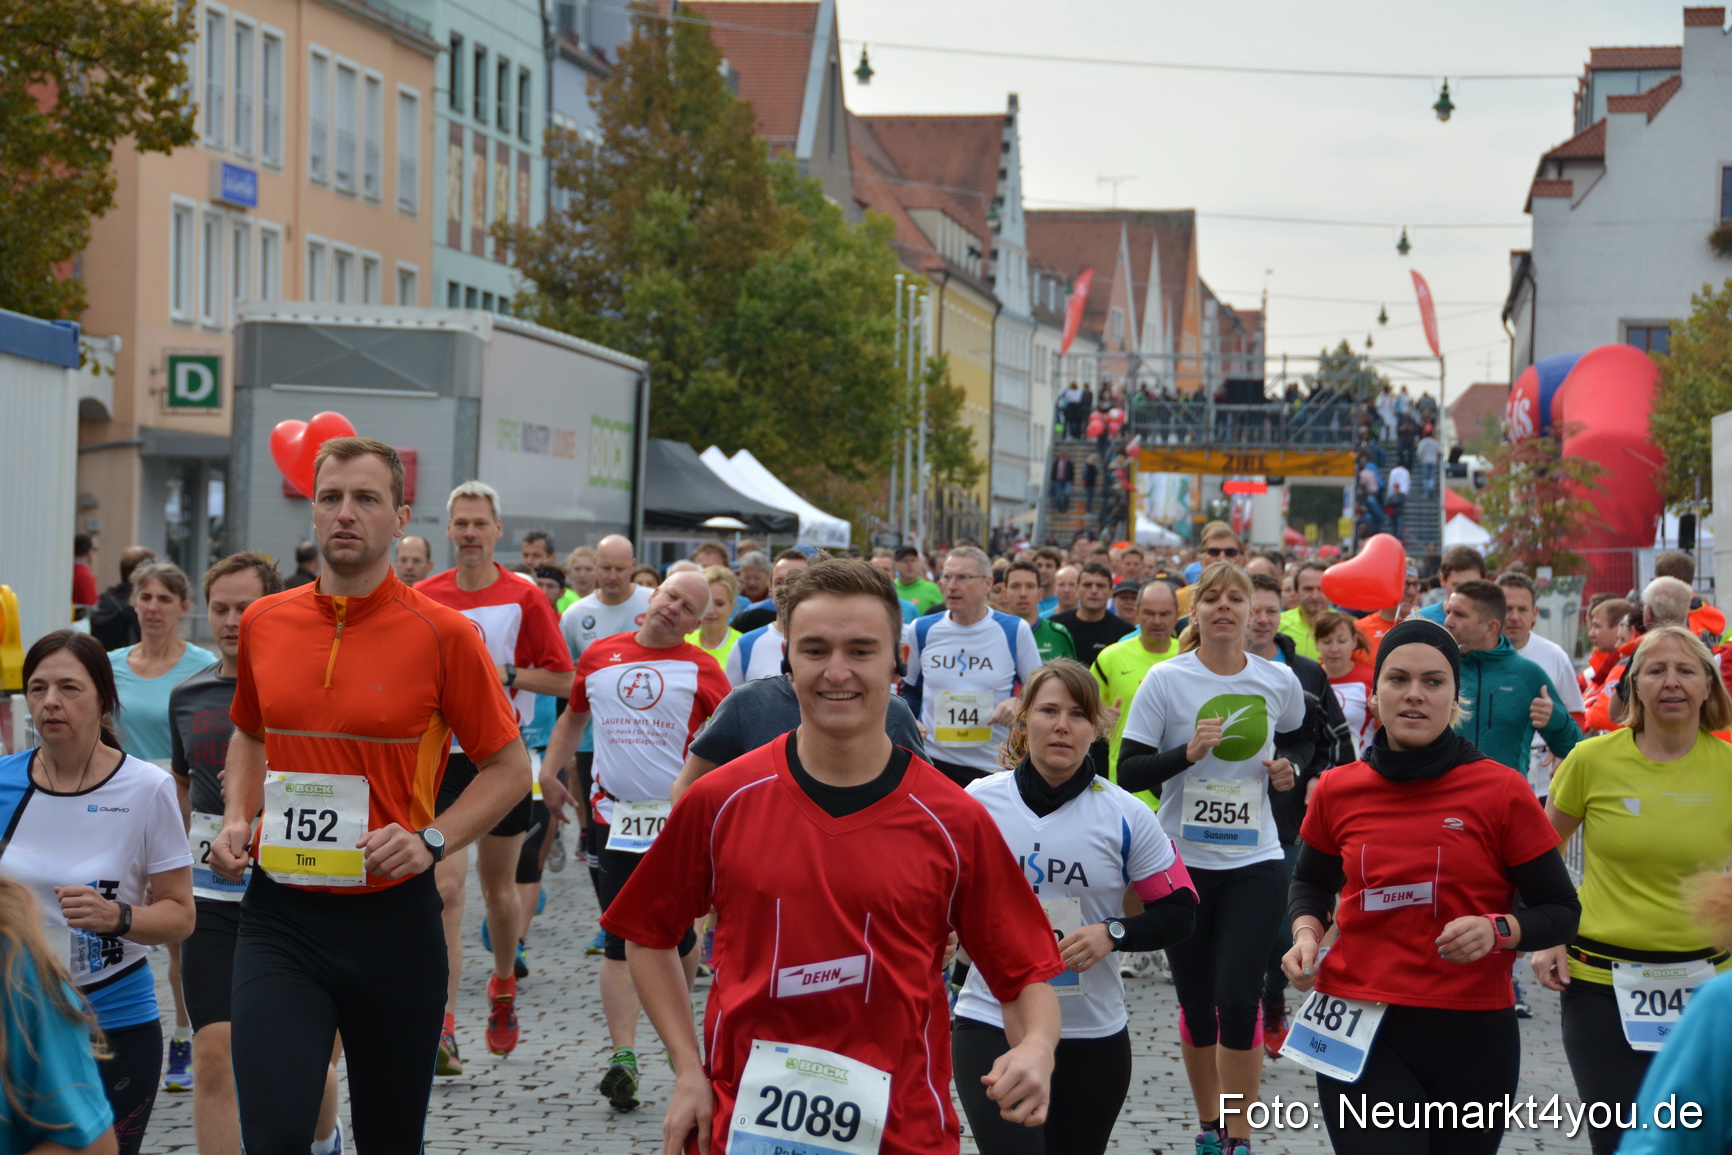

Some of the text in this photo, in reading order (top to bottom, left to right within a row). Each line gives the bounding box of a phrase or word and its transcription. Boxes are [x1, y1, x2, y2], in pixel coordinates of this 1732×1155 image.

[175, 362, 214, 402] D
[931, 649, 993, 677] SUSPA
[948, 708, 979, 725] 144
[294, 783, 334, 794] BOCK
[1194, 799, 1250, 824] 2554
[283, 807, 338, 842] 152
[620, 816, 667, 836] 2170
[1203, 830, 1239, 841] Susanne
[296, 853, 316, 866] Tim
[1383, 891, 1413, 904] DEHN
[802, 967, 842, 986] DEHN
[1653, 968, 1688, 978] BOCK
[1303, 993, 1364, 1038] 2481
[1309, 1036, 1327, 1053] Anja
[798, 1059, 849, 1081] BOCK
[754, 1085, 861, 1143] 2089
